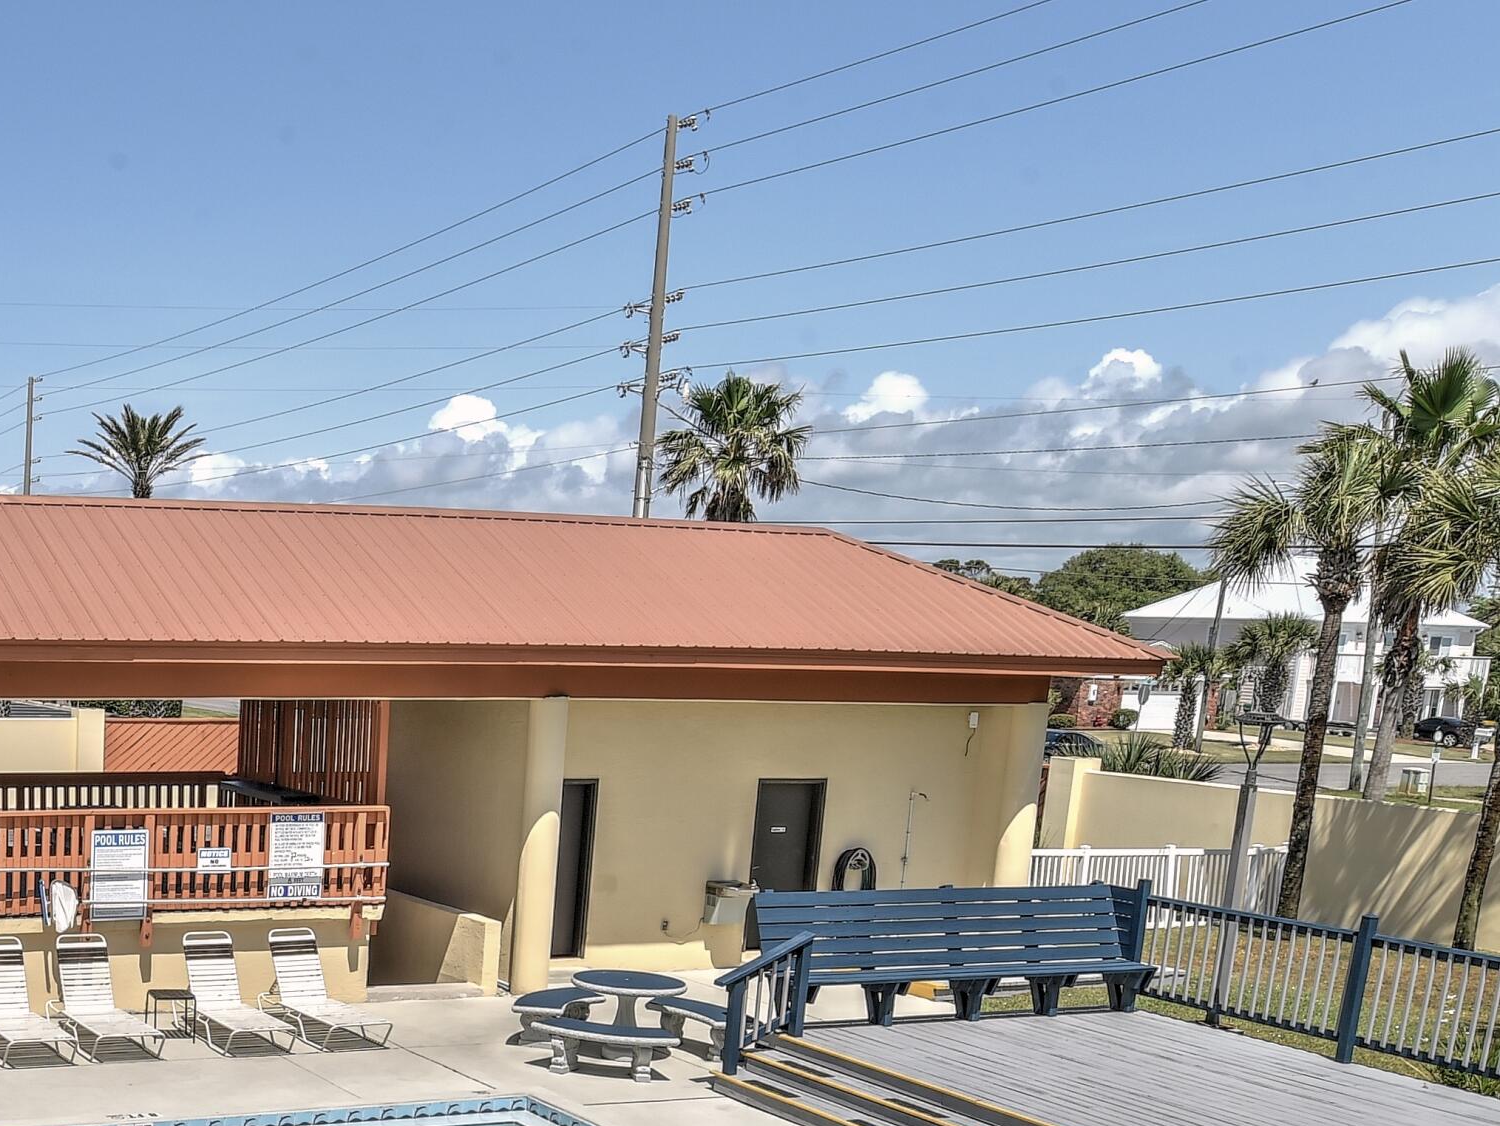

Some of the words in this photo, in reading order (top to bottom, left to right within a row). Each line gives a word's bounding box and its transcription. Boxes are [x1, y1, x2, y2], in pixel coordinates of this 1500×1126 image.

[95, 835, 117, 846] POOL
[119, 834, 146, 845] RULES
[201, 850, 228, 858] NOTICE
[270, 886, 284, 897] NO
[287, 885, 318, 896] DIVING
